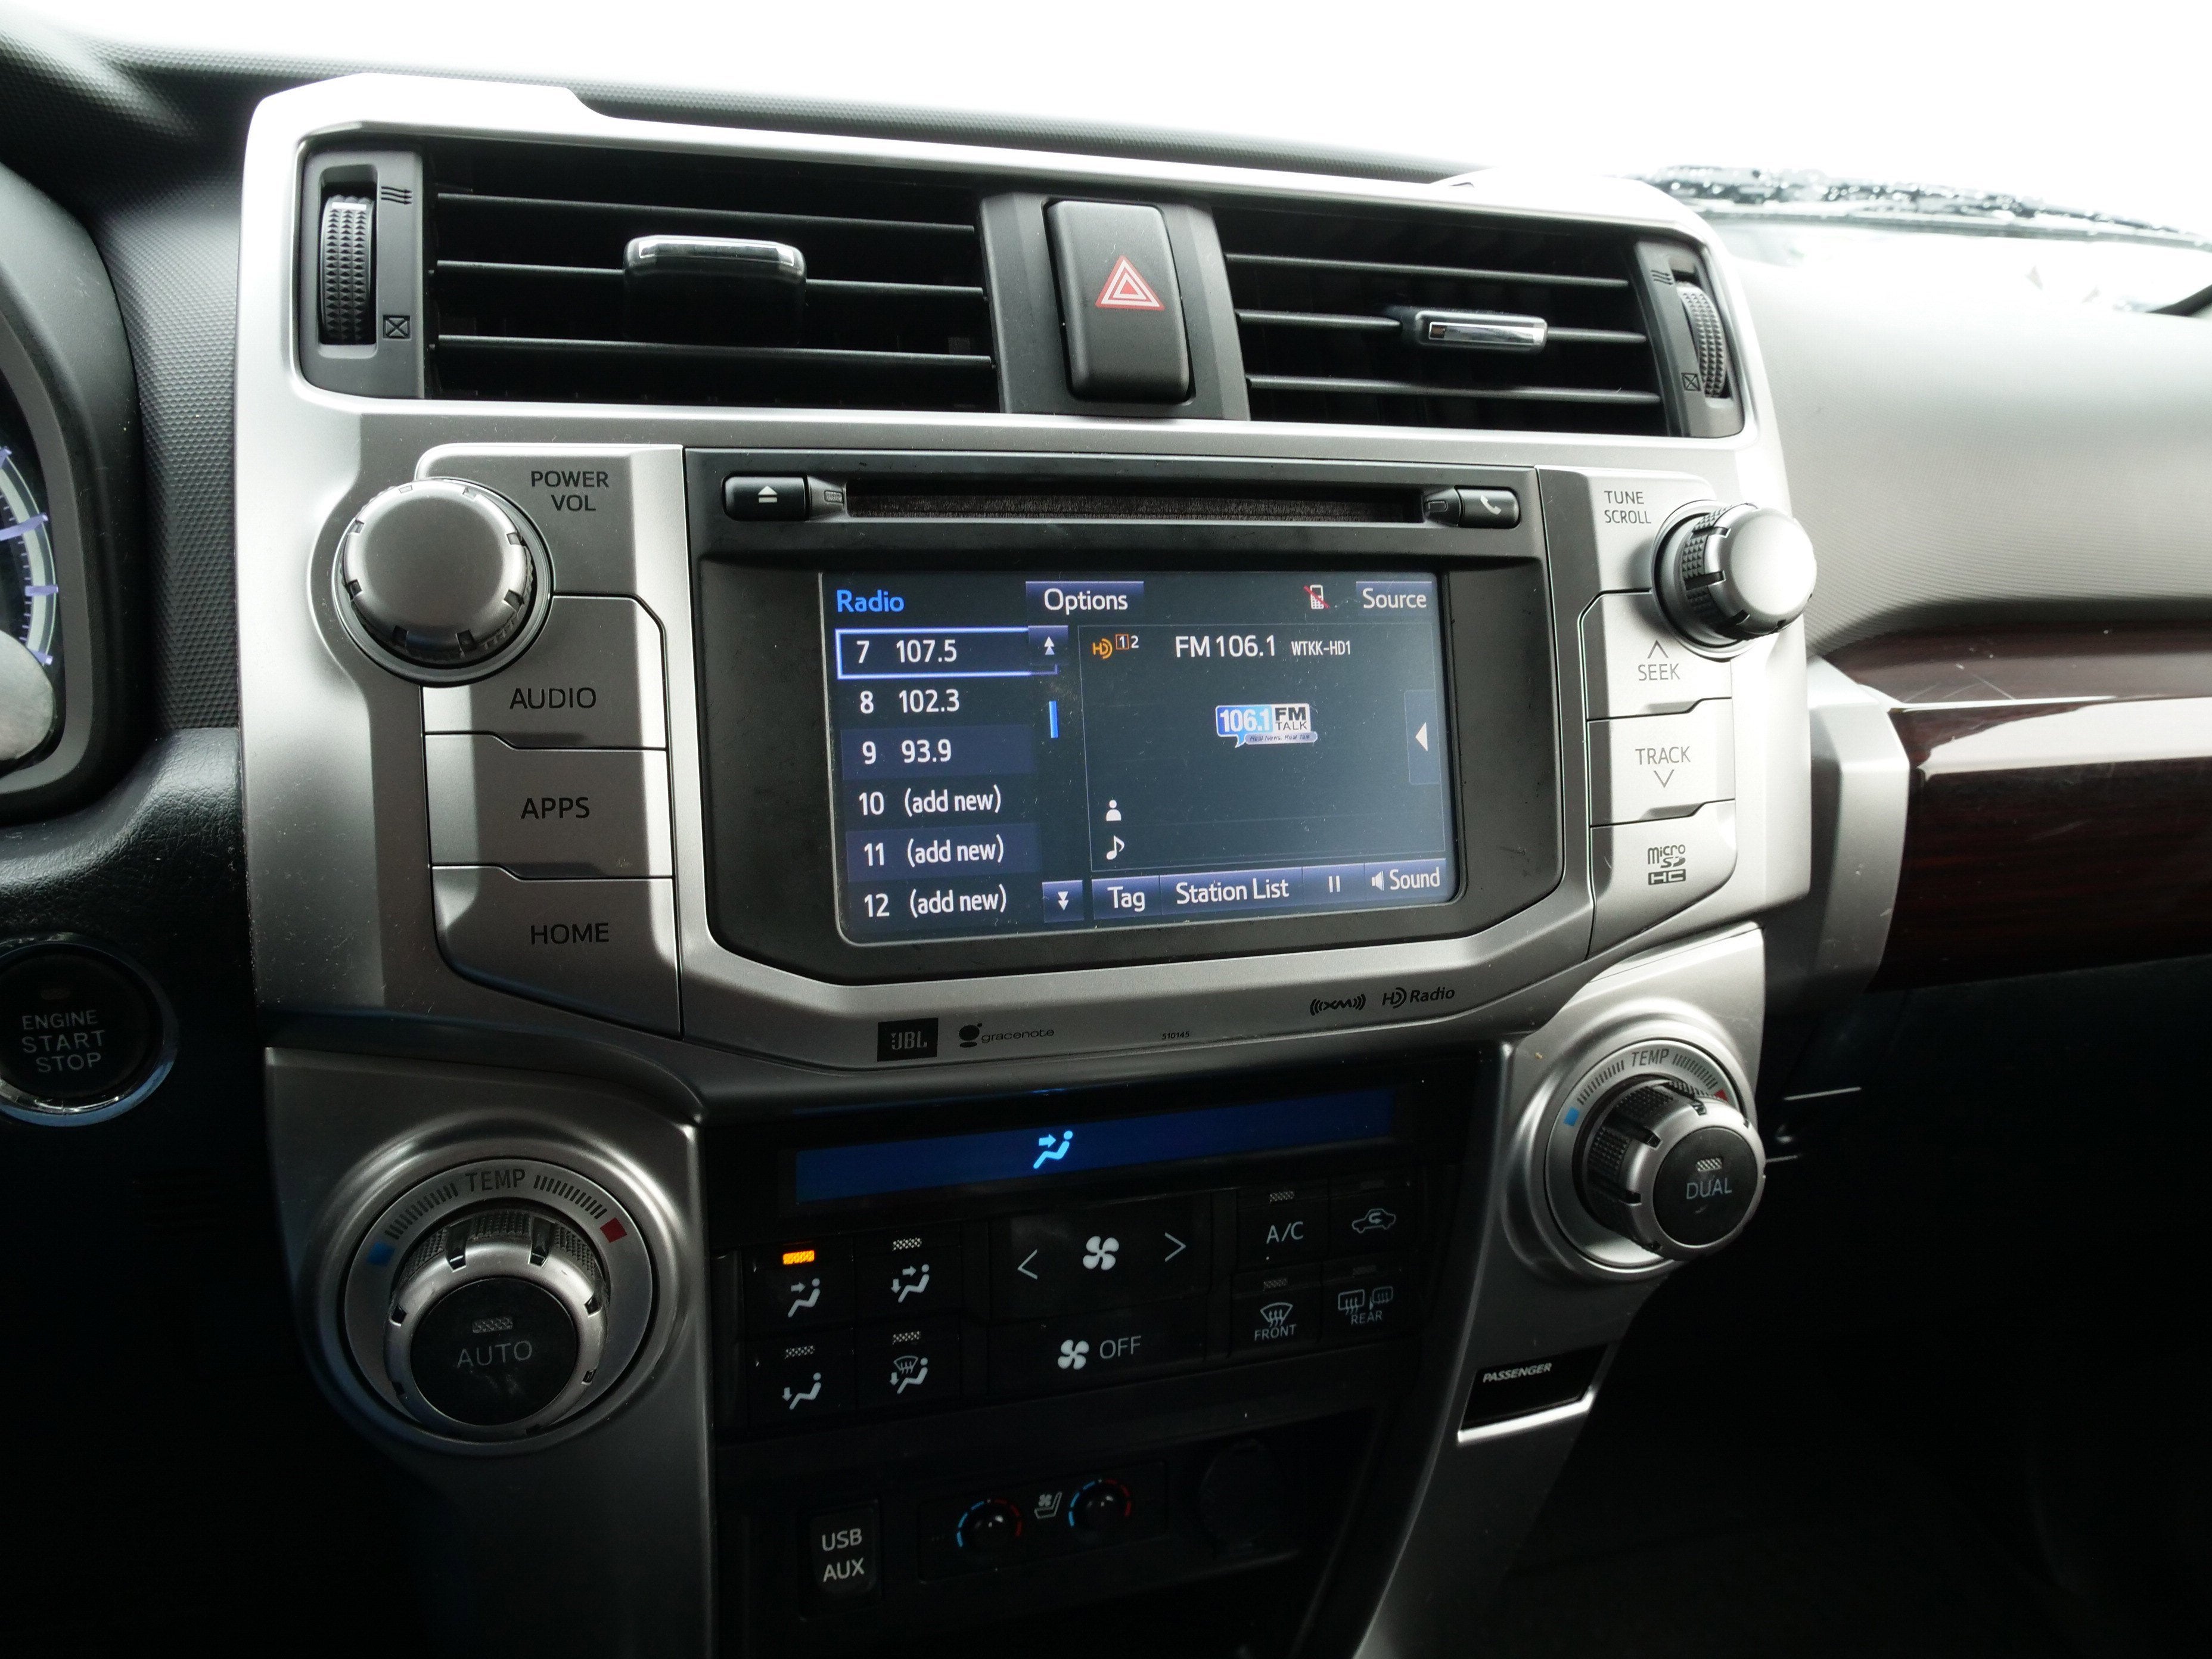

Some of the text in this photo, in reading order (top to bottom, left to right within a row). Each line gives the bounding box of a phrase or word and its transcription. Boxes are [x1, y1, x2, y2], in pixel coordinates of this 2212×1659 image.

[531, 471, 610, 487] POWER
[551, 495, 596, 511] VOL
[1604, 490, 1644, 505] TUNE
[1604, 509, 1651, 524] SCROLL
[837, 589, 905, 613] Radio
[1044, 588, 1128, 615] Options
[1362, 588, 1427, 608] Source
[856, 639, 957, 664] 7 107.5
[1216, 635, 1275, 657] 106.1
[1291, 641, 1351, 656] WTKK-HD1
[1638, 663, 1680, 681] SEEK
[509, 687, 597, 710] AUDIO
[860, 689, 960, 714] 8 102.3
[1220, 708, 1270, 732] 106.1
[1275, 707, 1306, 721] FM
[1275, 721, 1307, 731] TALK
[862, 739, 952, 765] 9 93.9
[1635, 746, 1691, 765] TRACK
[521, 796, 590, 819] APPS
[858, 784, 1001, 817] 10 (add new)
[864, 834, 1004, 867] 11 (add new)
[1648, 844, 1685, 864] micro
[1390, 866, 1440, 890] Sound
[1649, 869, 1685, 884] HC
[864, 884, 1006, 918] 12 (add new)
[1107, 886, 1145, 912] Tag
[1176, 877, 1290, 905] Station List
[530, 922, 609, 945] HOME
[1410, 987, 1455, 1003] Radio
[21, 1009, 98, 1030] ENGINE
[21, 1030, 105, 1054] START
[891, 1031, 927, 1050] JBL
[981, 1029, 1055, 1043] gracenote
[1161, 1031, 1190, 1040] 510145
[36, 1052, 101, 1073] STOP
[1631, 1049, 1669, 1067] TEMP
[465, 1169, 526, 1192] TEMP
[1686, 1180, 1732, 1200] DUAL
[1266, 1222, 1303, 1244] A/C
[1351, 1310, 1382, 1325] REAR
[1254, 1324, 1297, 1341] FRONT
[456, 1340, 533, 1368] AUTO
[1099, 1335, 1142, 1360] OFF
[1483, 1362, 1552, 1383] PASSENGER
[821, 1528, 863, 1552] USB
[822, 1557, 865, 1583] AUX
